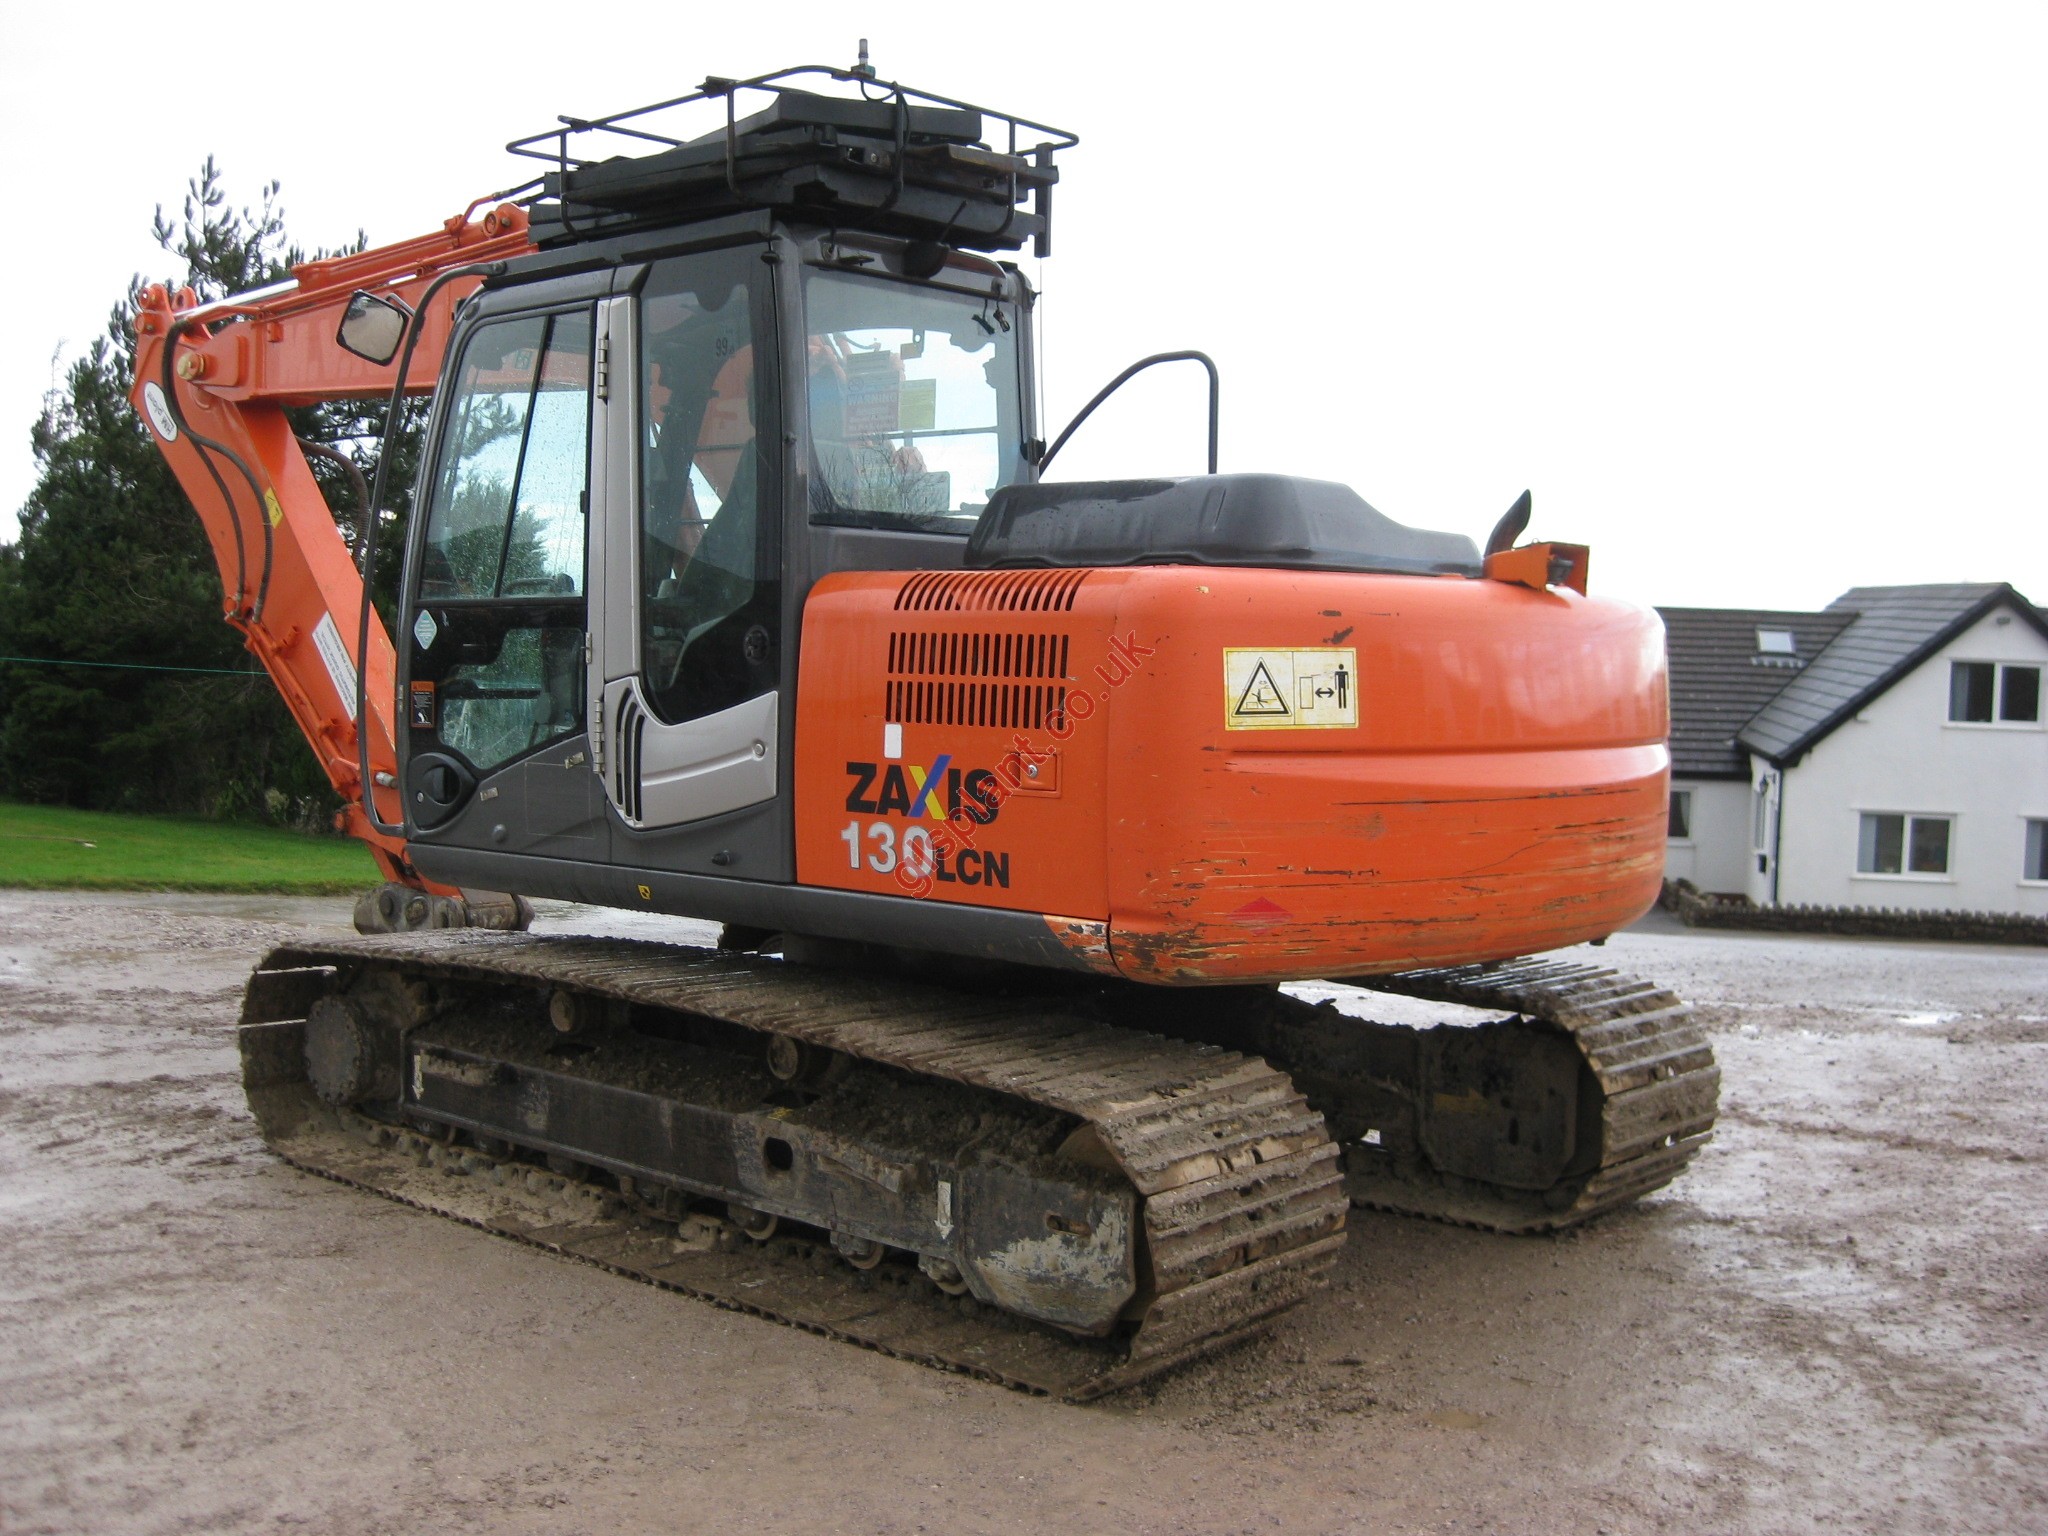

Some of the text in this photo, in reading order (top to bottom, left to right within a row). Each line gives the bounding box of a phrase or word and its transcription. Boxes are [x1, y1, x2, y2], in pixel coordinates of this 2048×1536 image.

[846, 754, 1000, 825] ZAXIS
[841, 820, 1010, 888] 130 LCN
